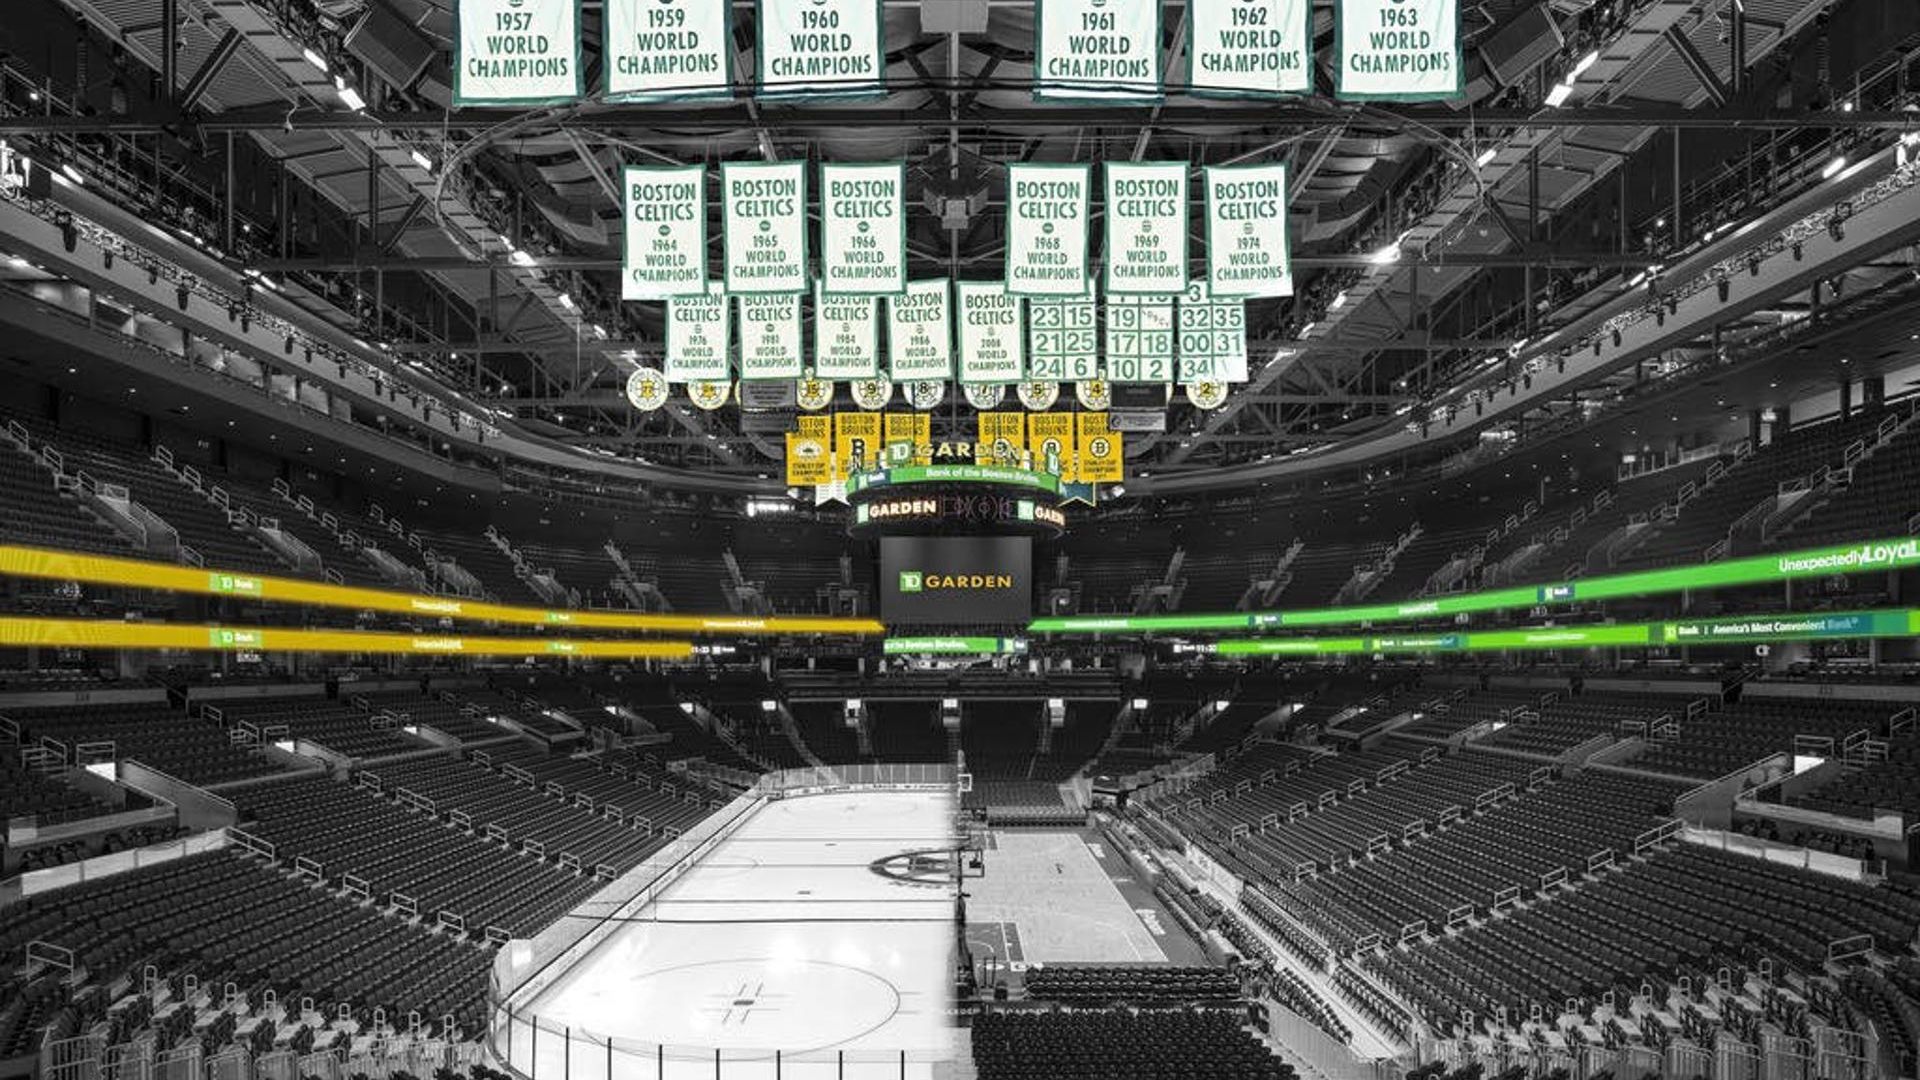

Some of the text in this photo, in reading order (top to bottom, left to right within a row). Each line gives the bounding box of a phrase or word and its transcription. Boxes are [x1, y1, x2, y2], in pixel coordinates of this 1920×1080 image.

[496, 13, 532, 30] 1957
[648, 9, 685, 27] 1959
[802, 11, 838, 28] 1960
[1082, 12, 1114, 30] 1961
[1232, 8, 1266, 26] 1962
[1380, 9, 1417, 26] 1963
[487, 36, 548, 54] WORLD
[638, 32, 698, 50] WORLD
[791, 34, 851, 52] WORLD
[1070, 35, 1130, 54] WORLD
[1220, 30, 1281, 49] WORLD
[1370, 31, 1430, 50] WORLD
[468, 58, 567, 77] CHAMPIONS
[618, 54, 718, 74] CHAMPIONS
[772, 55, 871, 76] CHAMPIONS
[1049, 58, 1150, 77] CHAMPIONS
[1202, 52, 1300, 72] CHAMPIONS
[1350, 52, 1450, 73] CHAMPIONS
[632, 183, 696, 200] BOSTON
[732, 179, 796, 197] BOSTON
[831, 180, 894, 198] BOSTON
[1017, 182, 1080, 199] BOSTON
[1115, 180, 1178, 196] BOSTON
[1216, 181, 1278, 199] BOSTON
[635, 204, 694, 221] CELTICS
[735, 199, 794, 217] CELTICS
[834, 200, 892, 218] CELTICS
[1019, 201, 1077, 218] CELTICS
[1117, 200, 1176, 216] CELTICS
[1218, 201, 1276, 219] CELTICS
[652, 239, 677, 250] 1964
[753, 235, 778, 246] 1965
[851, 236, 876, 248] 1966
[1035, 238, 1060, 249] 1968
[1134, 235, 1159, 247] 1969
[1237, 238, 1260, 249] 1974
[645, 254, 687, 266] WORLD
[746, 250, 786, 262] WORLD
[844, 251, 884, 263] WORLD
[1028, 252, 1068, 264] WORLD
[1127, 250, 1166, 262] WORLD
[1230, 252, 1270, 264] WORLD
[633, 268, 699, 282] CHAMPIONS
[733, 264, 799, 278] CHAMPIONS
[830, 266, 897, 278] CHAMPIONS
[1014, 266, 1080, 280] CHAMPIONS
[1114, 265, 1180, 278] CHAMPIONS
[1216, 266, 1282, 280] CHAMPIONS
[894, 292, 942, 307] BOSTON
[966, 294, 1014, 308] BOSTON
[675, 308, 720, 321] CELTICS
[748, 308, 792, 321] CELTICS
[823, 307, 868, 320] CELTICS
[896, 308, 941, 322] CELTICS
[968, 311, 1014, 324] CELTICS
[1033, 308, 1060, 326] 23
[1068, 308, 1092, 325] 15
[1112, 309, 1135, 327] 19
[1183, 309, 1208, 327] 32
[1215, 308, 1241, 326] 35
[1036, 334, 1059, 351] 21
[1067, 332, 1094, 351] 25
[1112, 334, 1136, 352] 17
[1144, 334, 1168, 352] 18
[1183, 335, 1209, 352] 00
[1218, 334, 1240, 351] 31
[682, 347, 714, 356] WORLD
[756, 346, 787, 356] WORLD
[830, 346, 861, 356] WORLD
[906, 347, 936, 356] WORLD
[977, 350, 1007, 358] WORLD
[1034, 359, 1060, 378] 24
[1074, 358, 1086, 376] 6
[1112, 360, 1135, 378] 10
[1150, 360, 1163, 378] 2
[1184, 360, 1209, 378] 34
[867, 383, 877, 395] 9
[920, 382, 929, 394] 8
[1033, 383, 1042, 394] 5
[1092, 383, 1100, 395] 4
[1202, 382, 1210, 394] 2
[888, 444, 908, 460] TD
[926, 469, 950, 478] Bank
[952, 469, 962, 477] of
[870, 500, 936, 518] GARDEN
[904, 574, 1012, 588] TD GARDEN
[1713, 623, 1750, 634] America's
[1752, 622, 1772, 632] Most
[1774, 618, 1826, 632] Convenient
